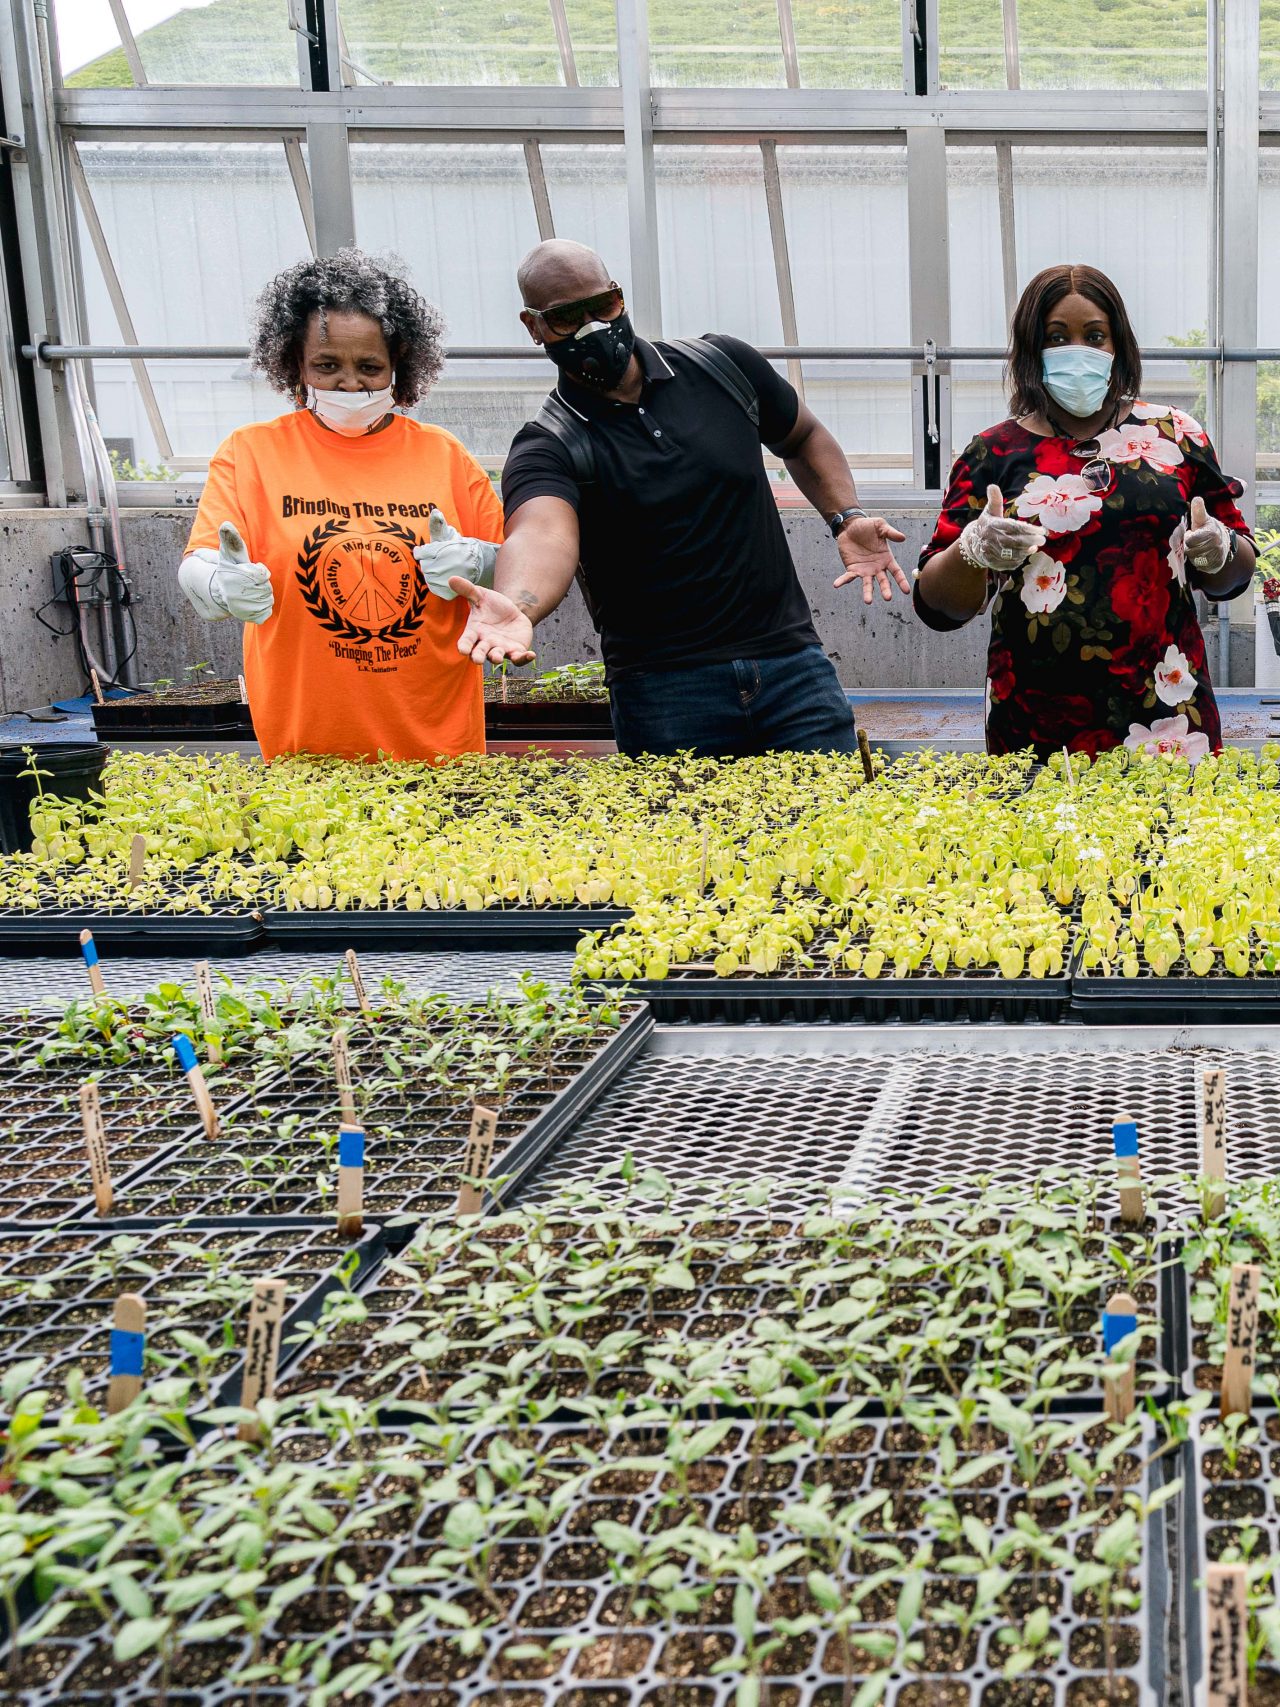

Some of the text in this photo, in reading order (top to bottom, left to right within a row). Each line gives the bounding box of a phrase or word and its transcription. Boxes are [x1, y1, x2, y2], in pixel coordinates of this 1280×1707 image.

[282, 495, 350, 519] Bringing
[353, 502, 384, 518] The
[326, 541, 410, 607] Healthy Mind Body Spirit
[374, 645, 391, 662] The
